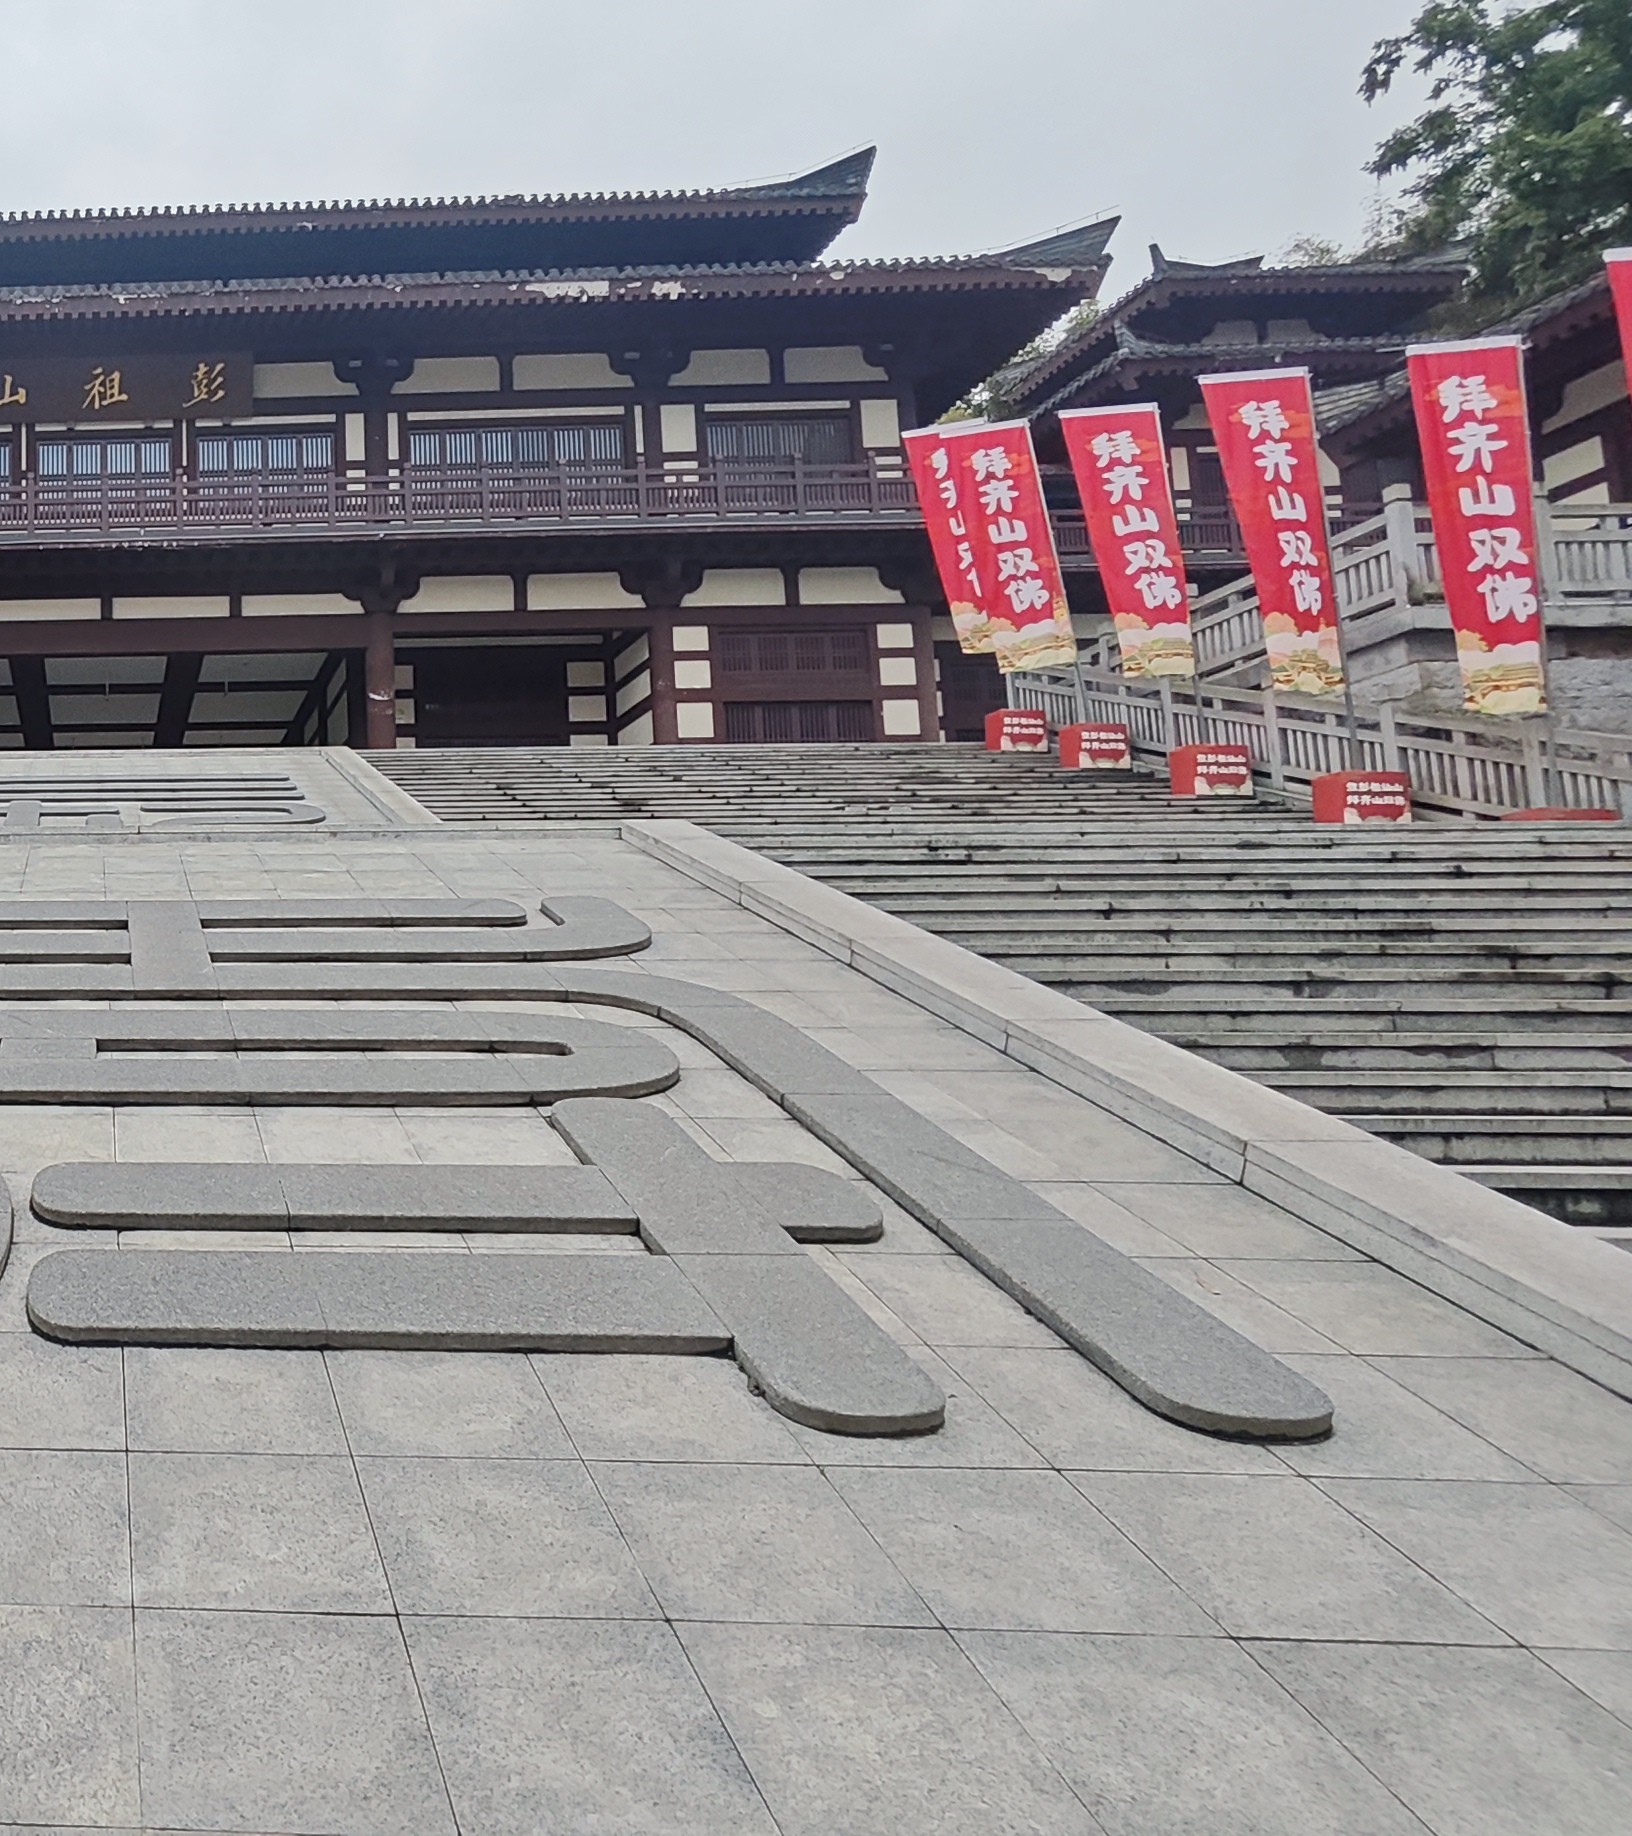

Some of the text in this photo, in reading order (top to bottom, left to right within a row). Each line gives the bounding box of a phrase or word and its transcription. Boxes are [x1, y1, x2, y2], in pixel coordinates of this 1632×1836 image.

[970, 446, 1050, 614] 拜齐山双佛
[1090, 430, 1183, 610] 拜齐山双佛
[1237, 400, 1323, 617] 拜齐山双佛
[1437, 375, 1538, 624] 拜齐山双佛
